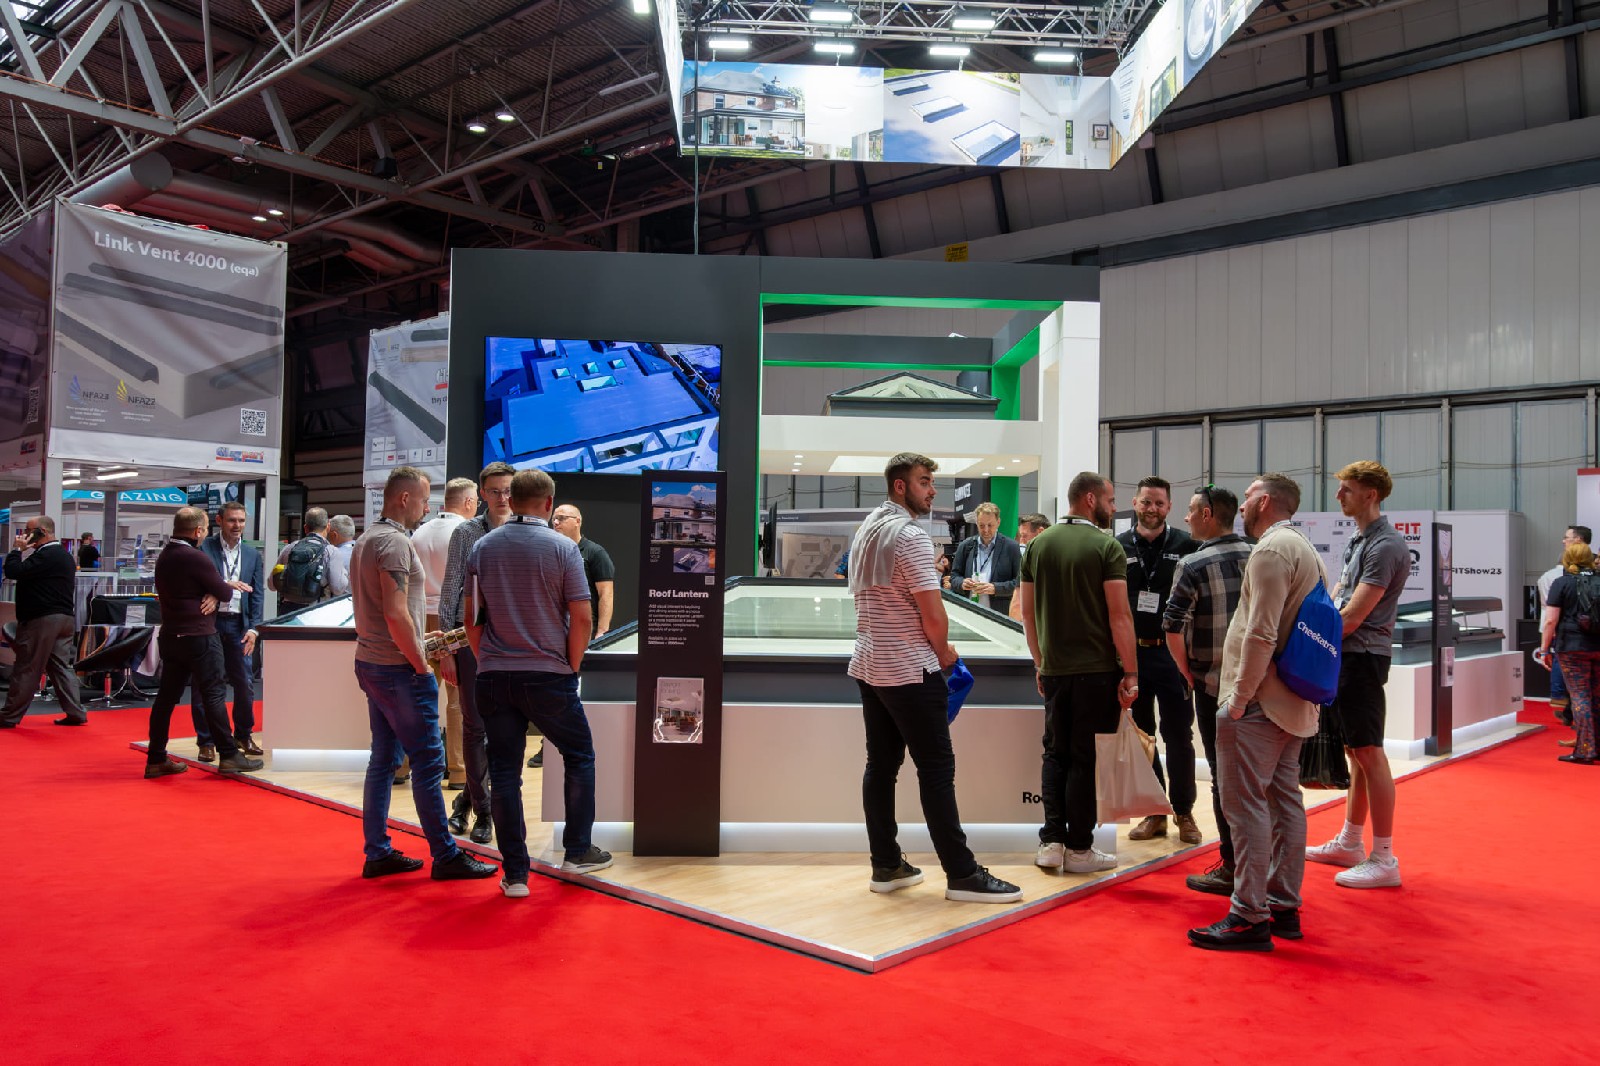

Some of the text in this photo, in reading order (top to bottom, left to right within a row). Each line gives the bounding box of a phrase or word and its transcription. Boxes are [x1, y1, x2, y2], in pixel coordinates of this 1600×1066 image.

[94, 231, 259, 277] Link Vent 4000 (eqa)
[128, 396, 156, 406] NFA22
[90, 490, 183, 502] GAZING
[1394, 522, 1421, 535] FIT
[648, 589, 709, 598] Roof Lantern
[1022, 791, 1043, 804] Ro
